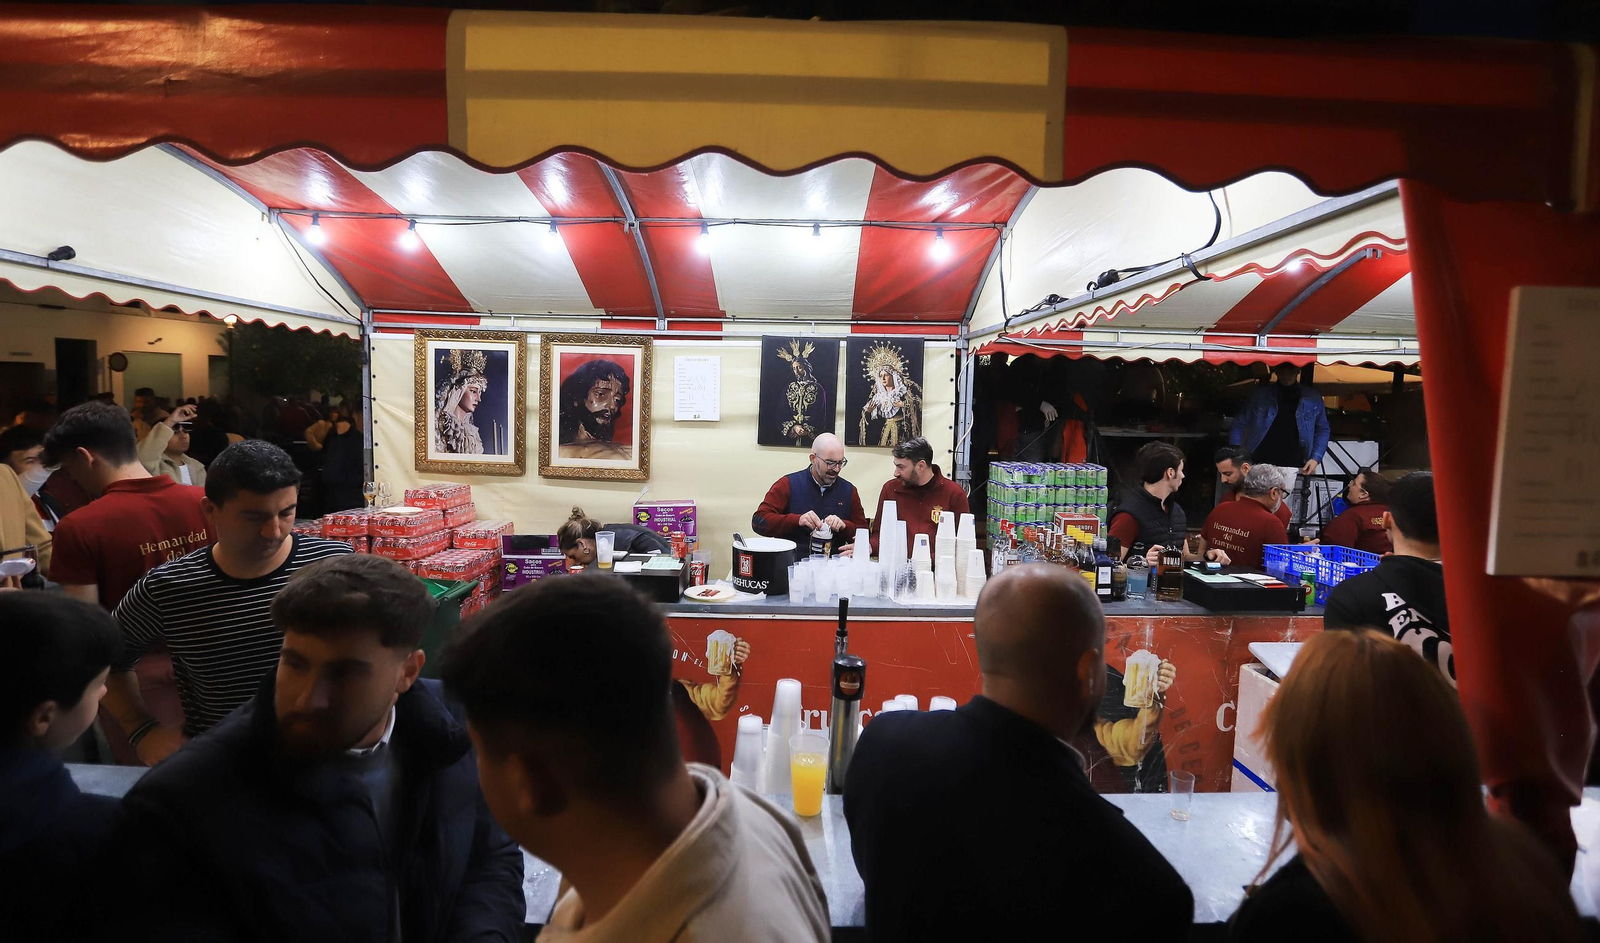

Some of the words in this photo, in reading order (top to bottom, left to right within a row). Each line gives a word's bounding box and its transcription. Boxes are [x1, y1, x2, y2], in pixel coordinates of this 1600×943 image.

[1213, 521, 1250, 538] Hermandad
[1222, 532, 1233, 542] del
[733, 576, 768, 590] REHUCAS
